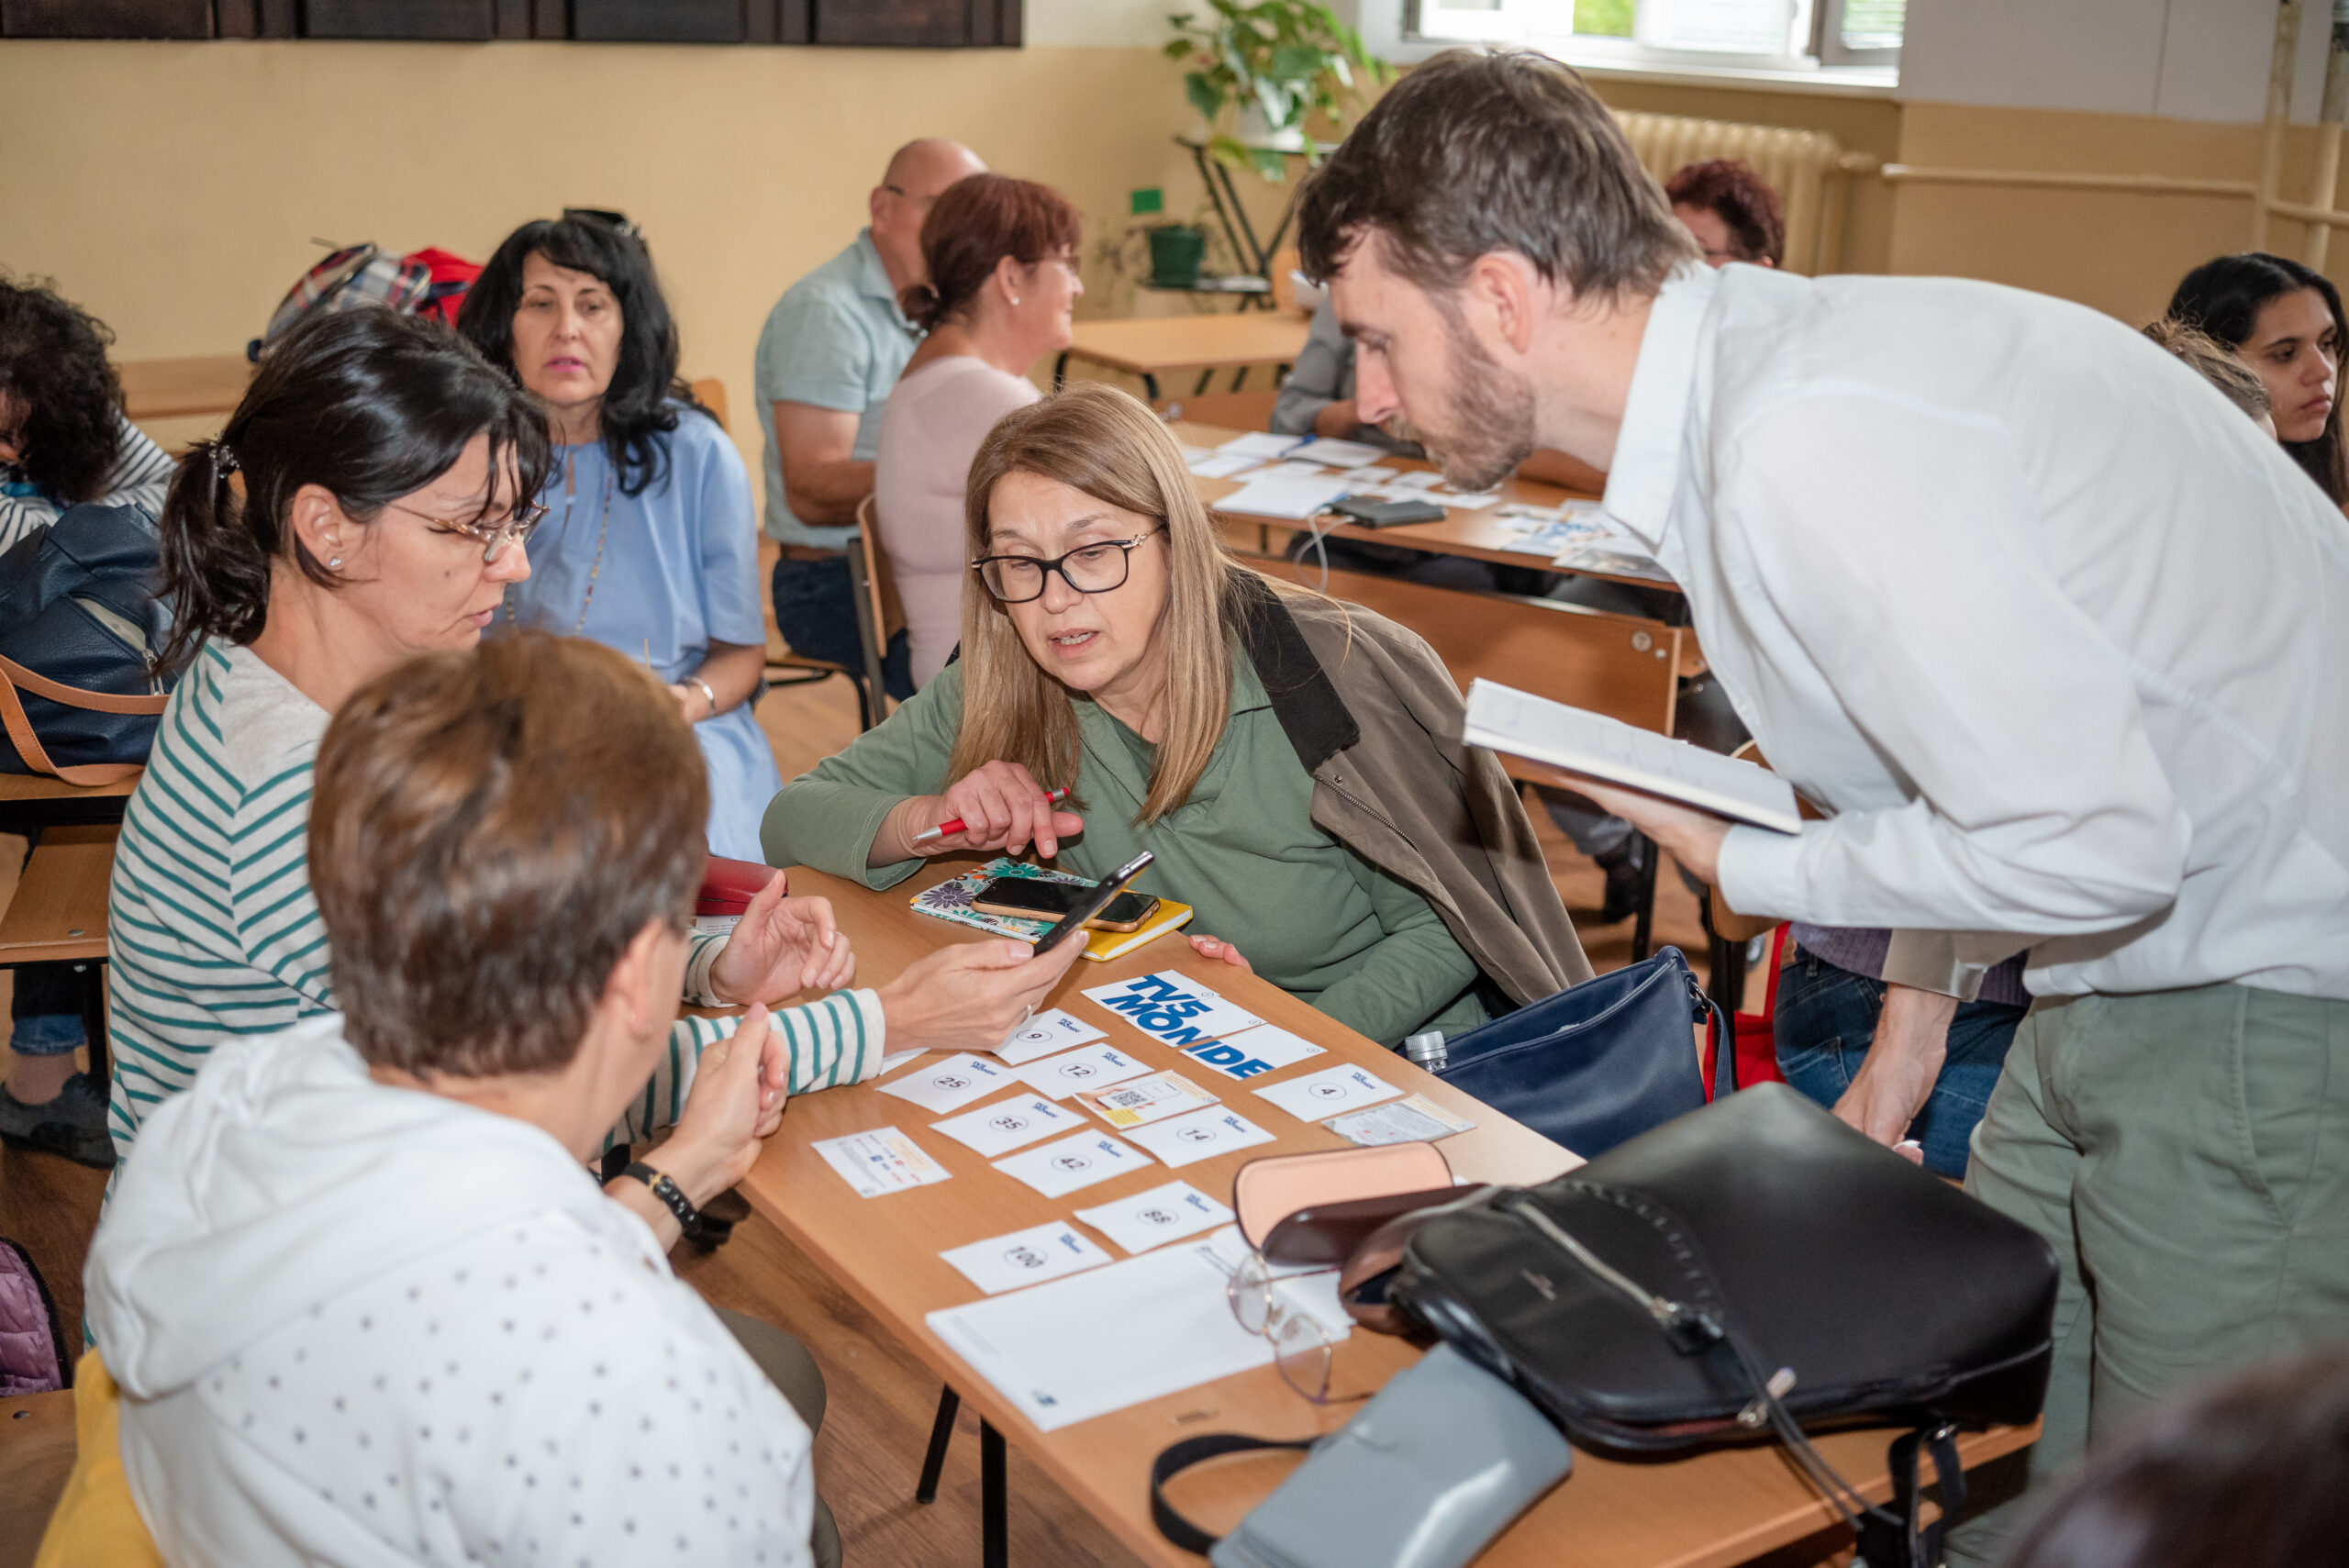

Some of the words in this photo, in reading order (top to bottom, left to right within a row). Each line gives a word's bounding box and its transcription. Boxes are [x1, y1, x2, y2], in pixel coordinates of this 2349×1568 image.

[1126, 974, 1214, 1018] TV5
[1100, 994, 1278, 1080] MONDE
[1067, 1065, 1091, 1077] 12
[938, 1076, 967, 1088] 25
[996, 1117, 1023, 1129] 35
[1185, 1129, 1210, 1141] 14
[1060, 1157, 1085, 1170] 42
[1008, 1246, 1044, 1269] 100
